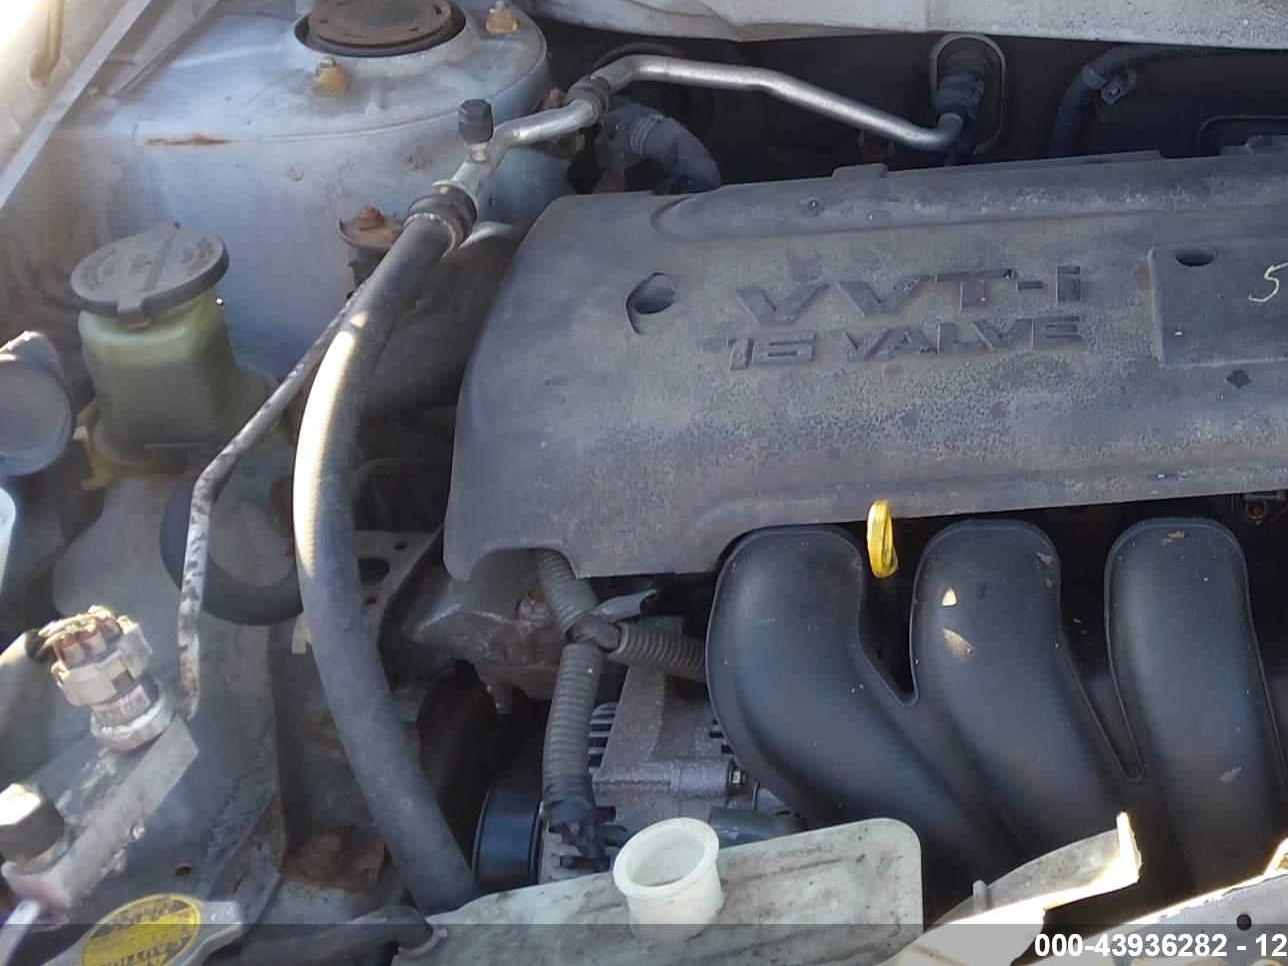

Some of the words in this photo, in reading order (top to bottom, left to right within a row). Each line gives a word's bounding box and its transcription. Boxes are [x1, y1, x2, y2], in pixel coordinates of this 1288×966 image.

[729, 332, 816, 371] 16
[832, 315, 1083, 363] VALVE
[103, 939, 182, 966] CAUTI
